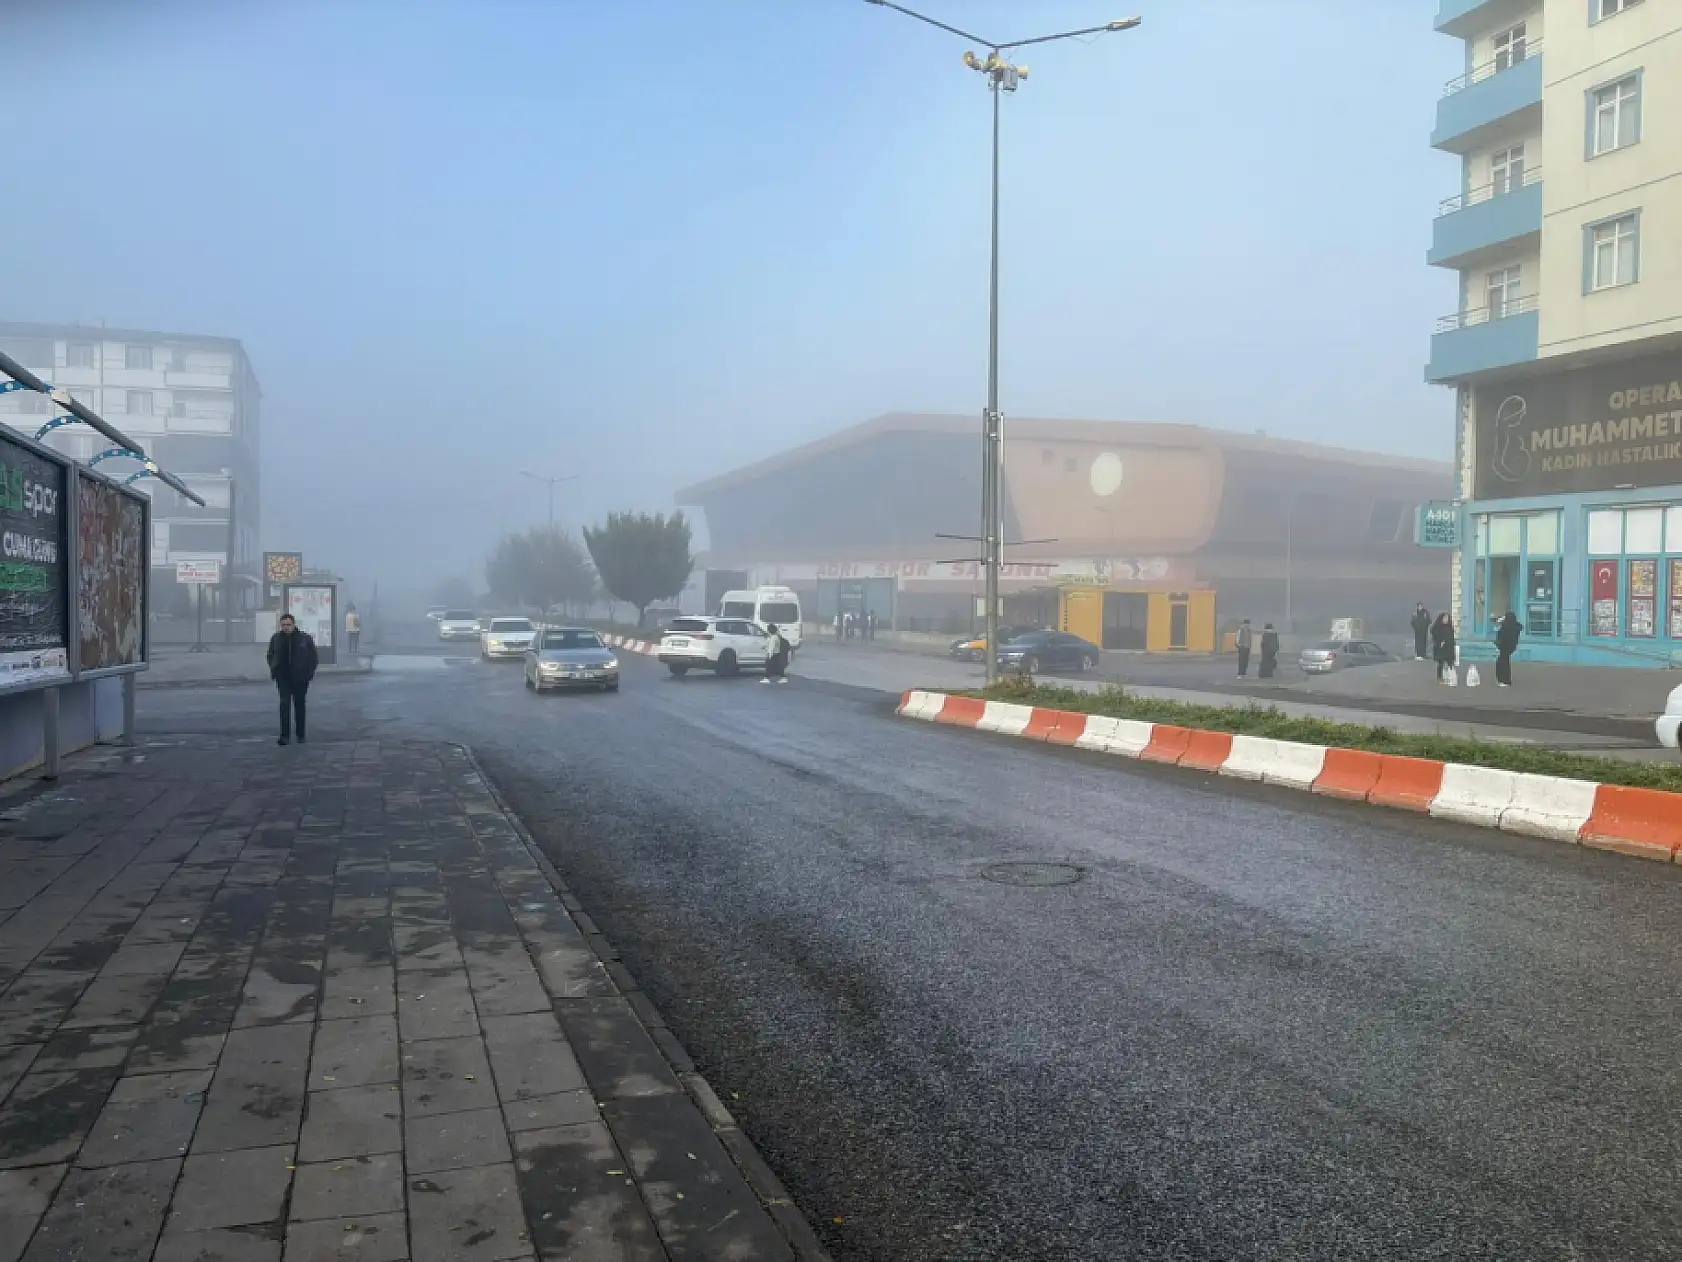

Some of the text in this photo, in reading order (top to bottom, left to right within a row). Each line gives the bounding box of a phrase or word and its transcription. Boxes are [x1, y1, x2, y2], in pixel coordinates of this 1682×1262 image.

[1608, 380, 1682, 409] OPERA
[1530, 409, 1682, 452] MUHAMMET
[1541, 441, 1682, 472] KADIN HASTALIK
